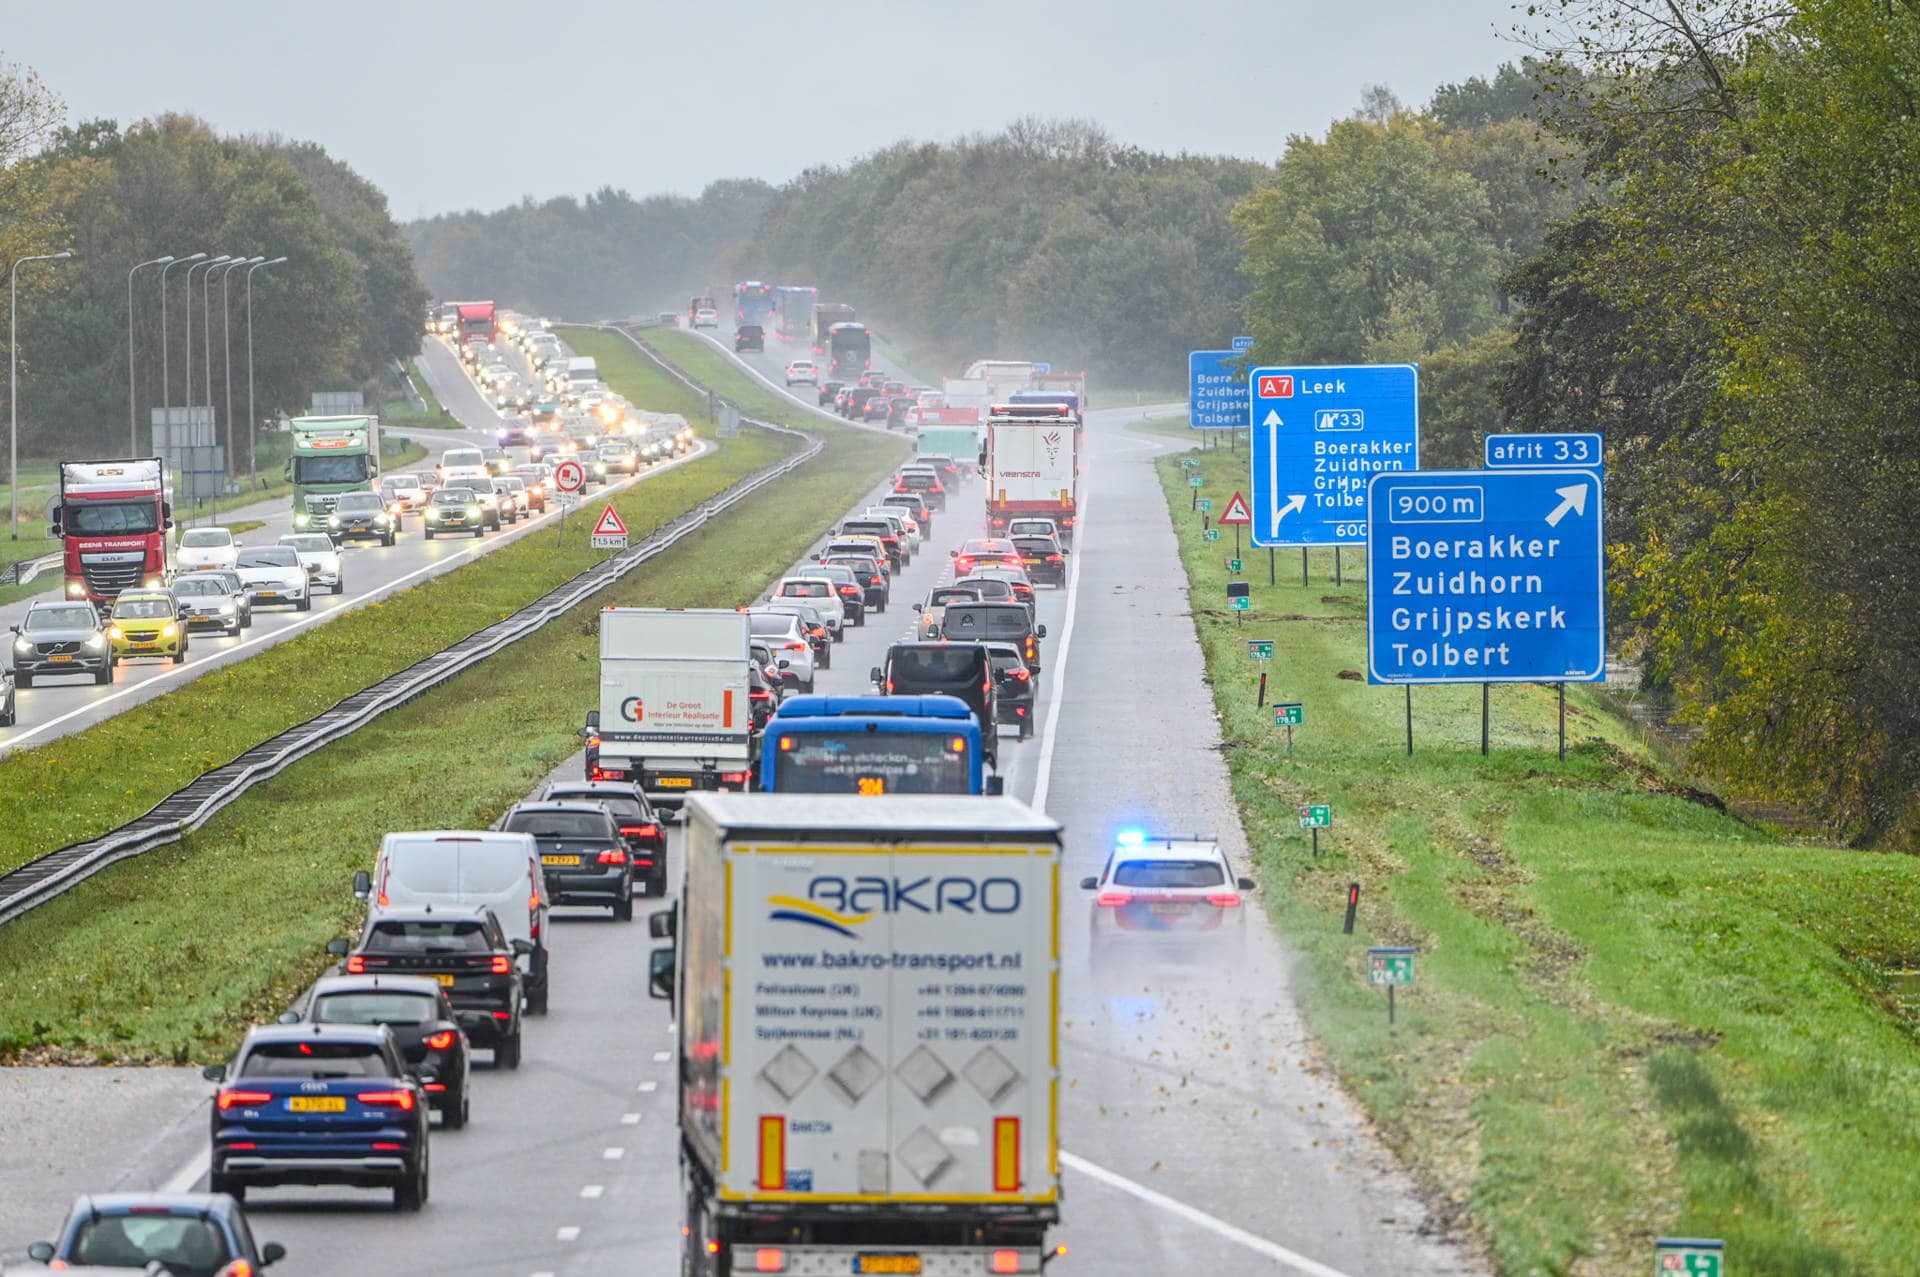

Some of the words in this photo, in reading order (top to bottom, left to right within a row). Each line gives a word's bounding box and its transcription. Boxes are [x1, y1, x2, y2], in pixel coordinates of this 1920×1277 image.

[1263, 379, 1290, 394] A7
[1302, 379, 1346, 394] Leek
[1197, 414, 1241, 423] Tolbert
[1340, 413, 1361, 426] 33
[1314, 440, 1412, 455] Boerakker
[1494, 443, 1543, 459] afrit
[1554, 440, 1588, 460] 33
[1314, 458, 1402, 472] Zuidhorn
[1398, 496, 1447, 514] 900
[1453, 497, 1474, 513] m
[1392, 534, 1560, 559] Boerakker
[1392, 571, 1542, 594] Zuidhorn
[1392, 606, 1566, 638] Grijpskerk
[1392, 642, 1510, 667] Tolbert
[808, 876, 1022, 914] BAKRO
[762, 951, 1022, 973] www.bakro-transport.nl
